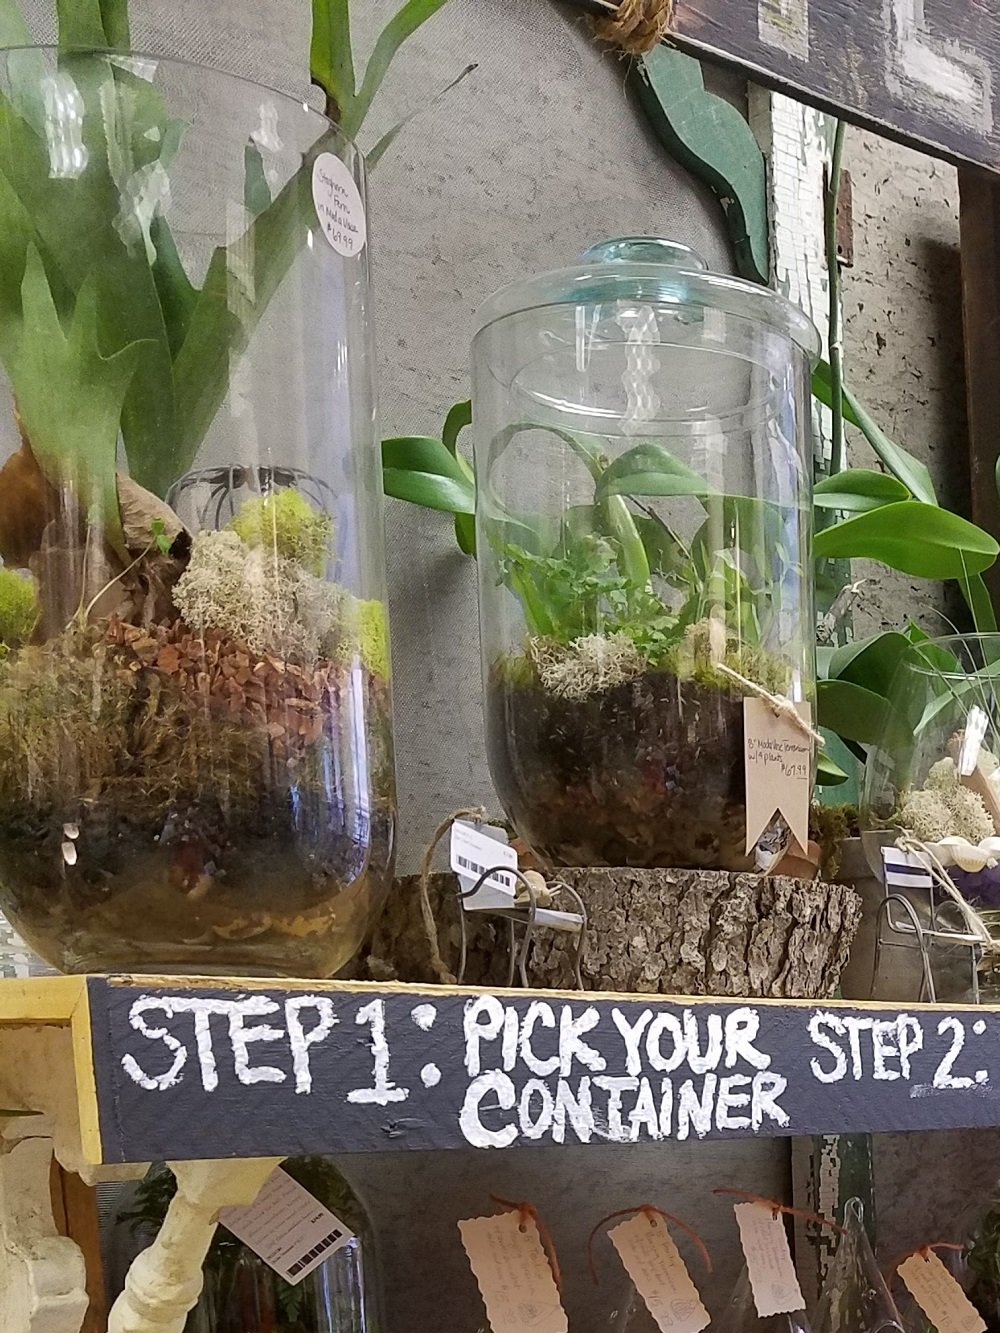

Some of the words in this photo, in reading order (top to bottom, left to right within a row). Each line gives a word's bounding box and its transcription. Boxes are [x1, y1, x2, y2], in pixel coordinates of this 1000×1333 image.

[121, 994, 341, 1094] STEP
[462, 994, 608, 1077] PICK
[610, 1005, 773, 1078] YOUR
[807, 1008, 924, 1084] STEP
[457, 1069, 792, 1149] CONTAINER
